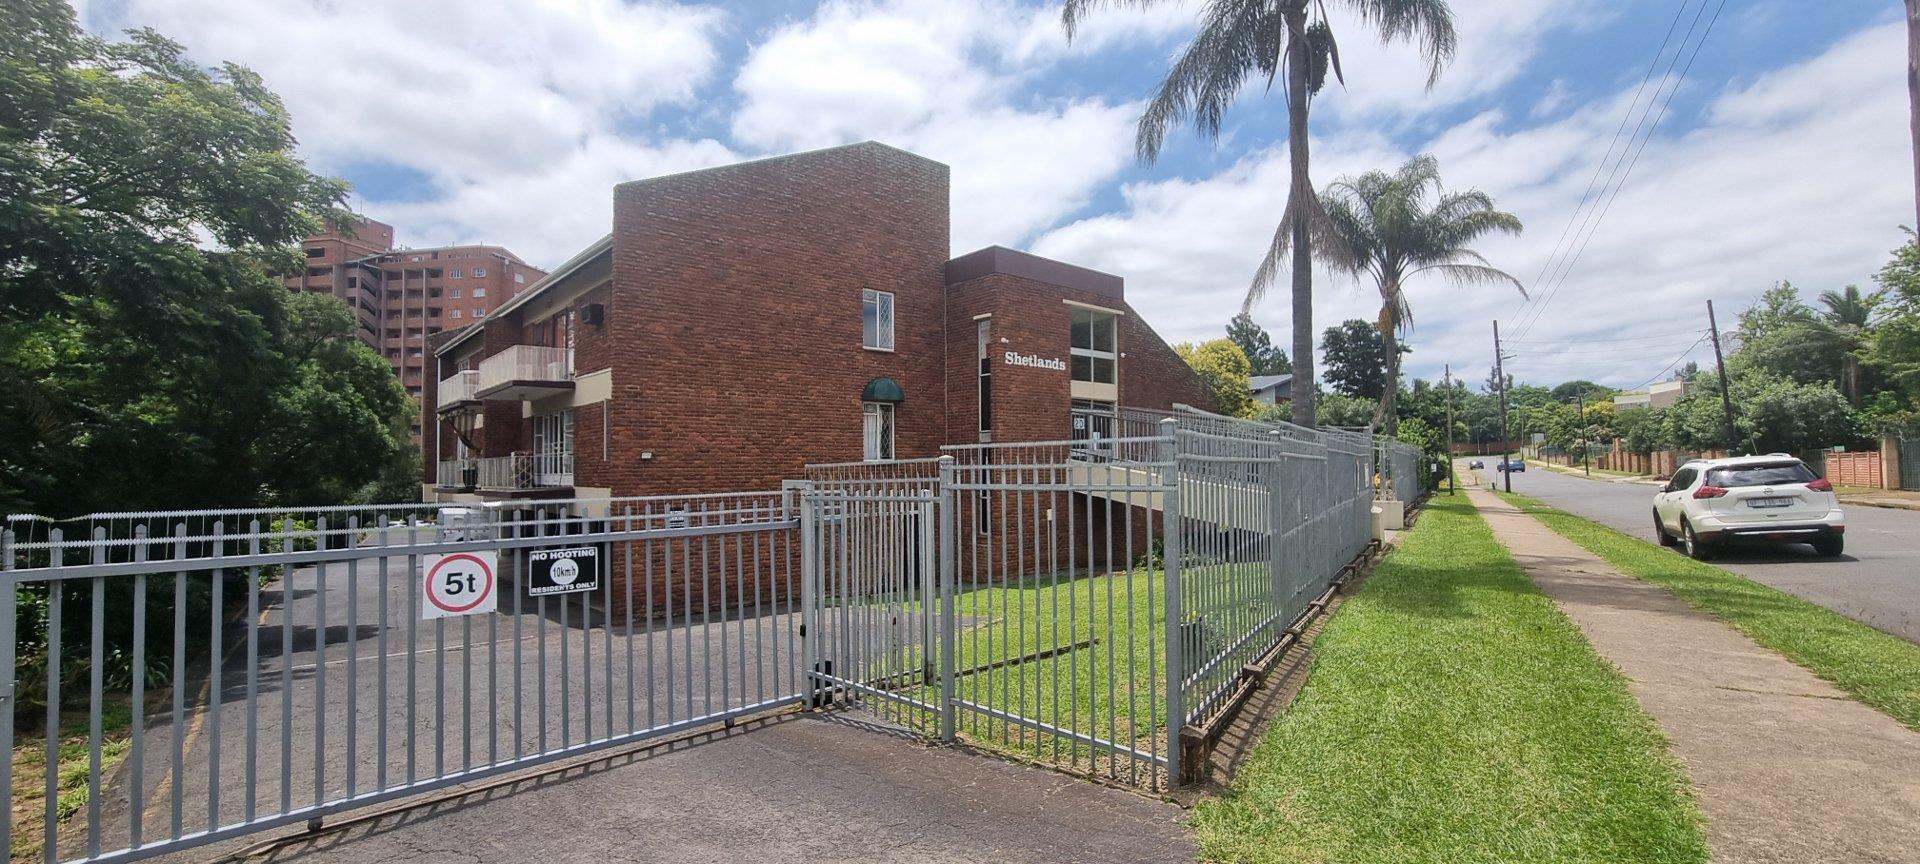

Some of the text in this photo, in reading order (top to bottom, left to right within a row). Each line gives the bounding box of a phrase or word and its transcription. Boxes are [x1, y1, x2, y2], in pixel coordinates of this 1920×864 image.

[1004, 351, 1066, 371] Shetlands
[531, 549, 595, 561] NO HOOTING
[444, 571, 476, 596] 5t
[531, 581, 595, 594] RESIDENTS ONLY
